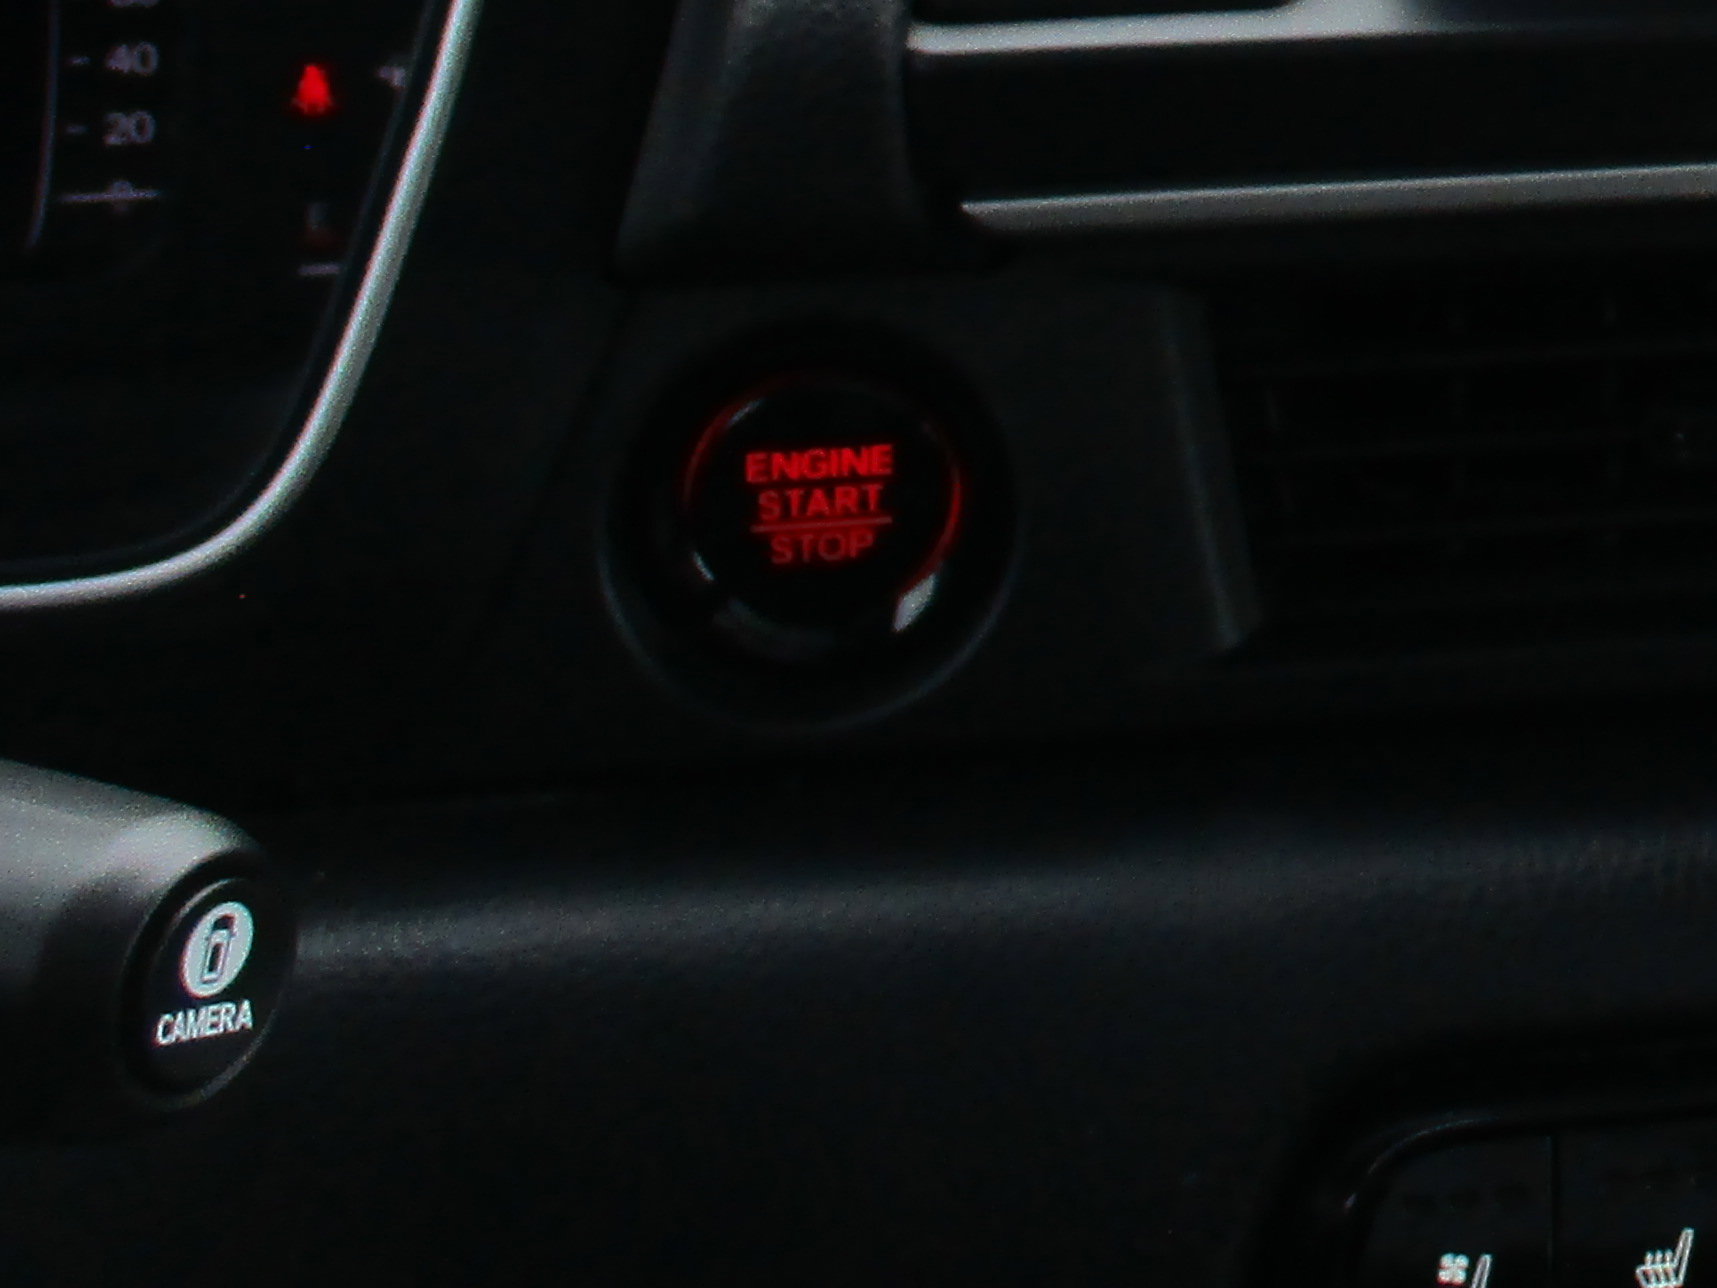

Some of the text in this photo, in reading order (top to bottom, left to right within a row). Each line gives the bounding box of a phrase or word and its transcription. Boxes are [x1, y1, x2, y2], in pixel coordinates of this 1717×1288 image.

[107, 41, 159, 76] 40
[104, 110, 156, 146] 20
[745, 444, 893, 483] ENGINE
[758, 484, 882, 520] START
[769, 527, 875, 564] STOP
[155, 996, 253, 1046] CAMERA
